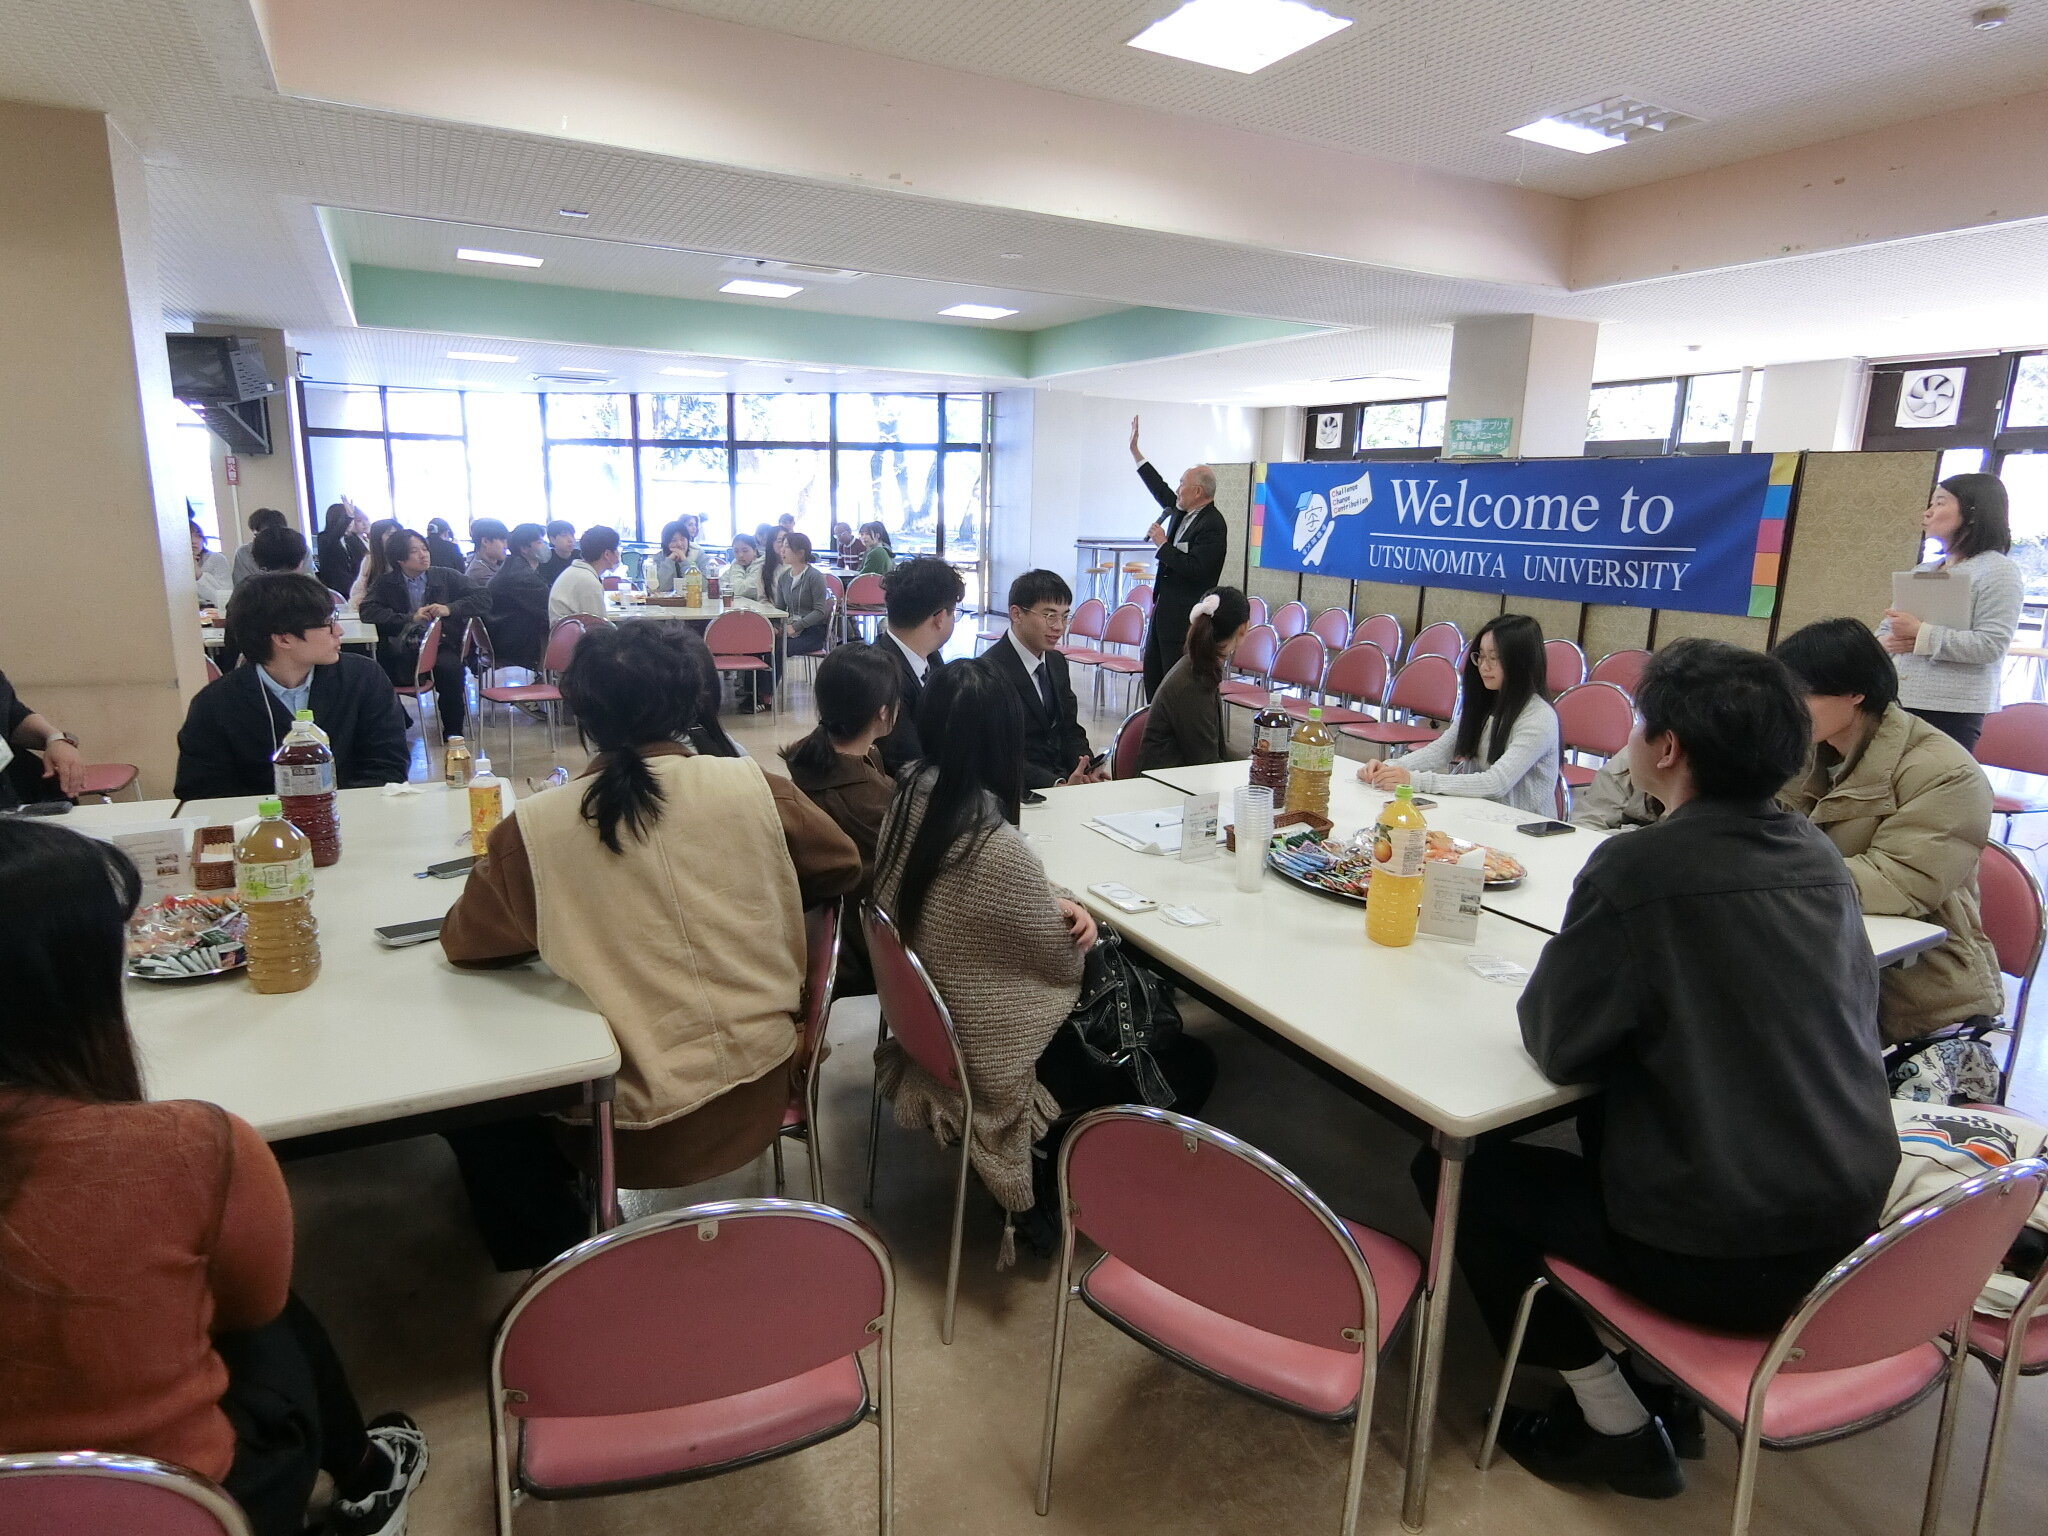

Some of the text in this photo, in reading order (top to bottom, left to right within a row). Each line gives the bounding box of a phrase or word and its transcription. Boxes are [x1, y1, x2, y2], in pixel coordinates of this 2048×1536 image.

[1390, 478, 1675, 535] Welcome to
[1369, 544, 1692, 592] UTSUNOMIYA UNIVERSITY
